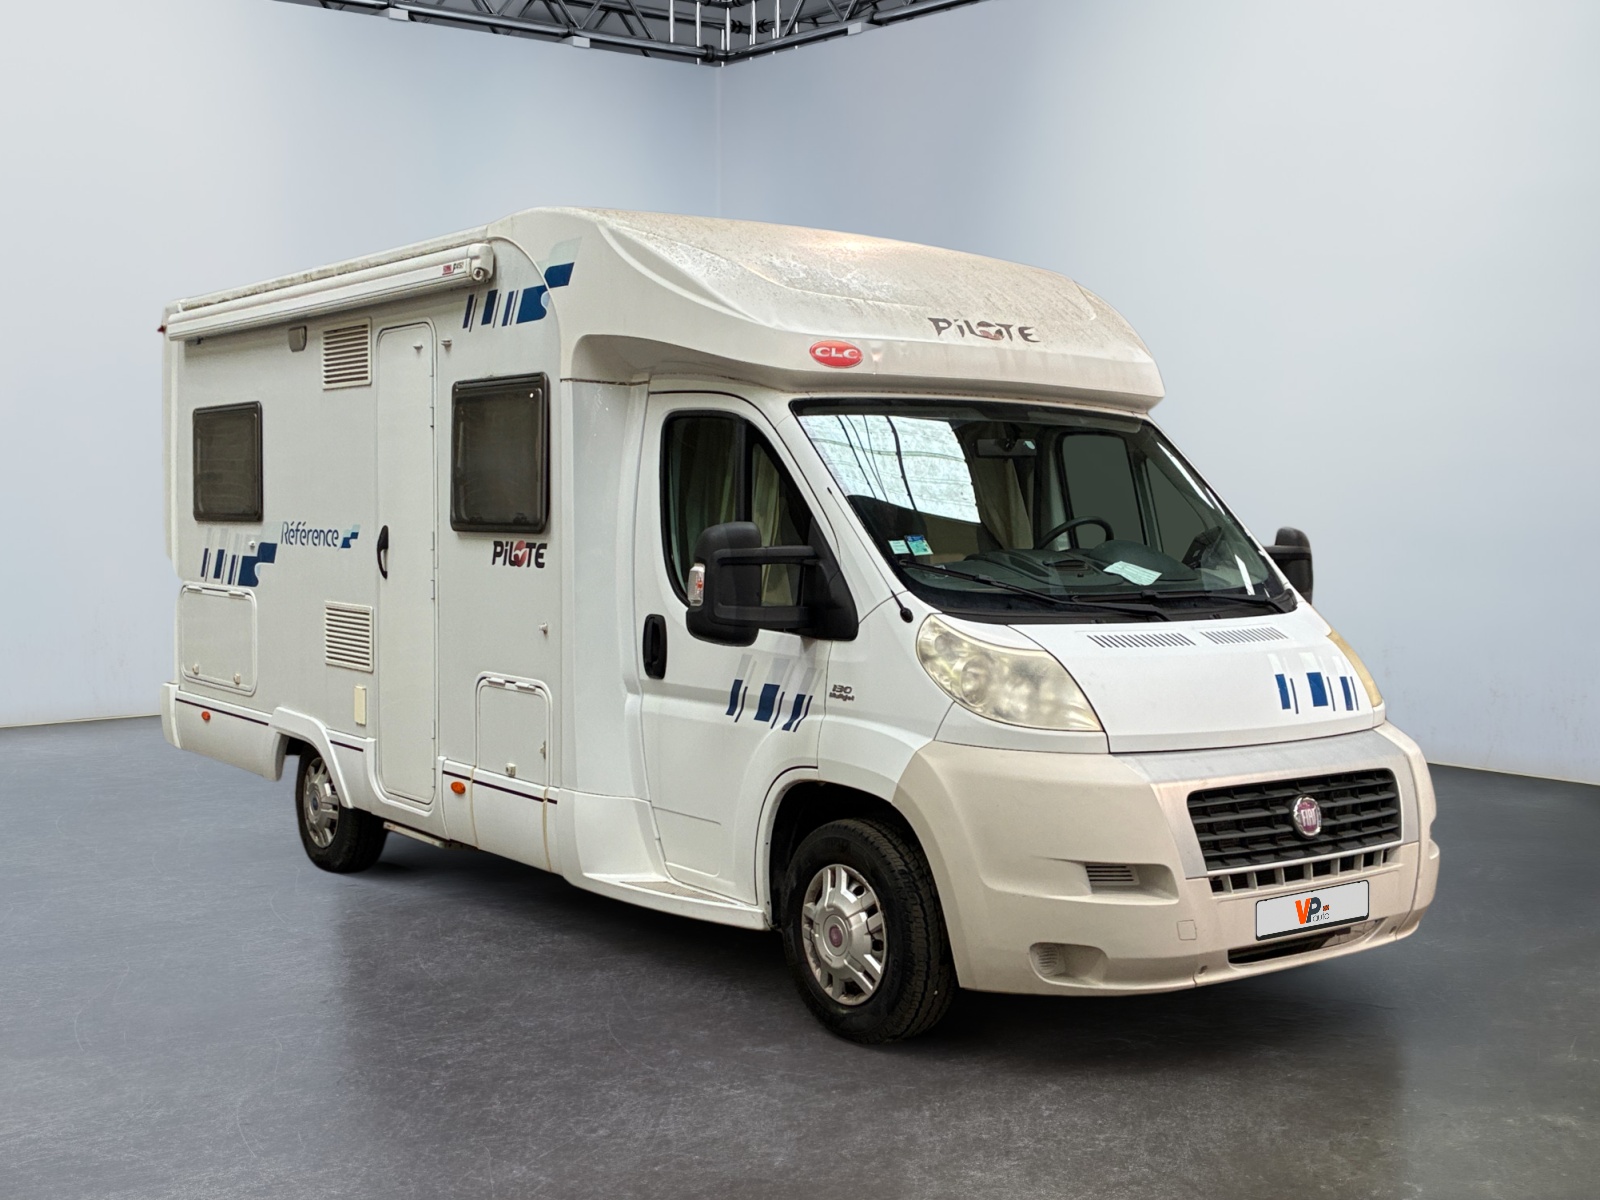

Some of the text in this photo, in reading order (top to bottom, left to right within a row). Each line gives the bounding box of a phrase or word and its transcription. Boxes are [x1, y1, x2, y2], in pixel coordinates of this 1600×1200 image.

[815, 347, 859, 359] CLC
[281, 521, 339, 547] Référence
[832, 684, 853, 695] 130
[1300, 808, 1318, 828] FIAT
[1295, 896, 1322, 925] VP
